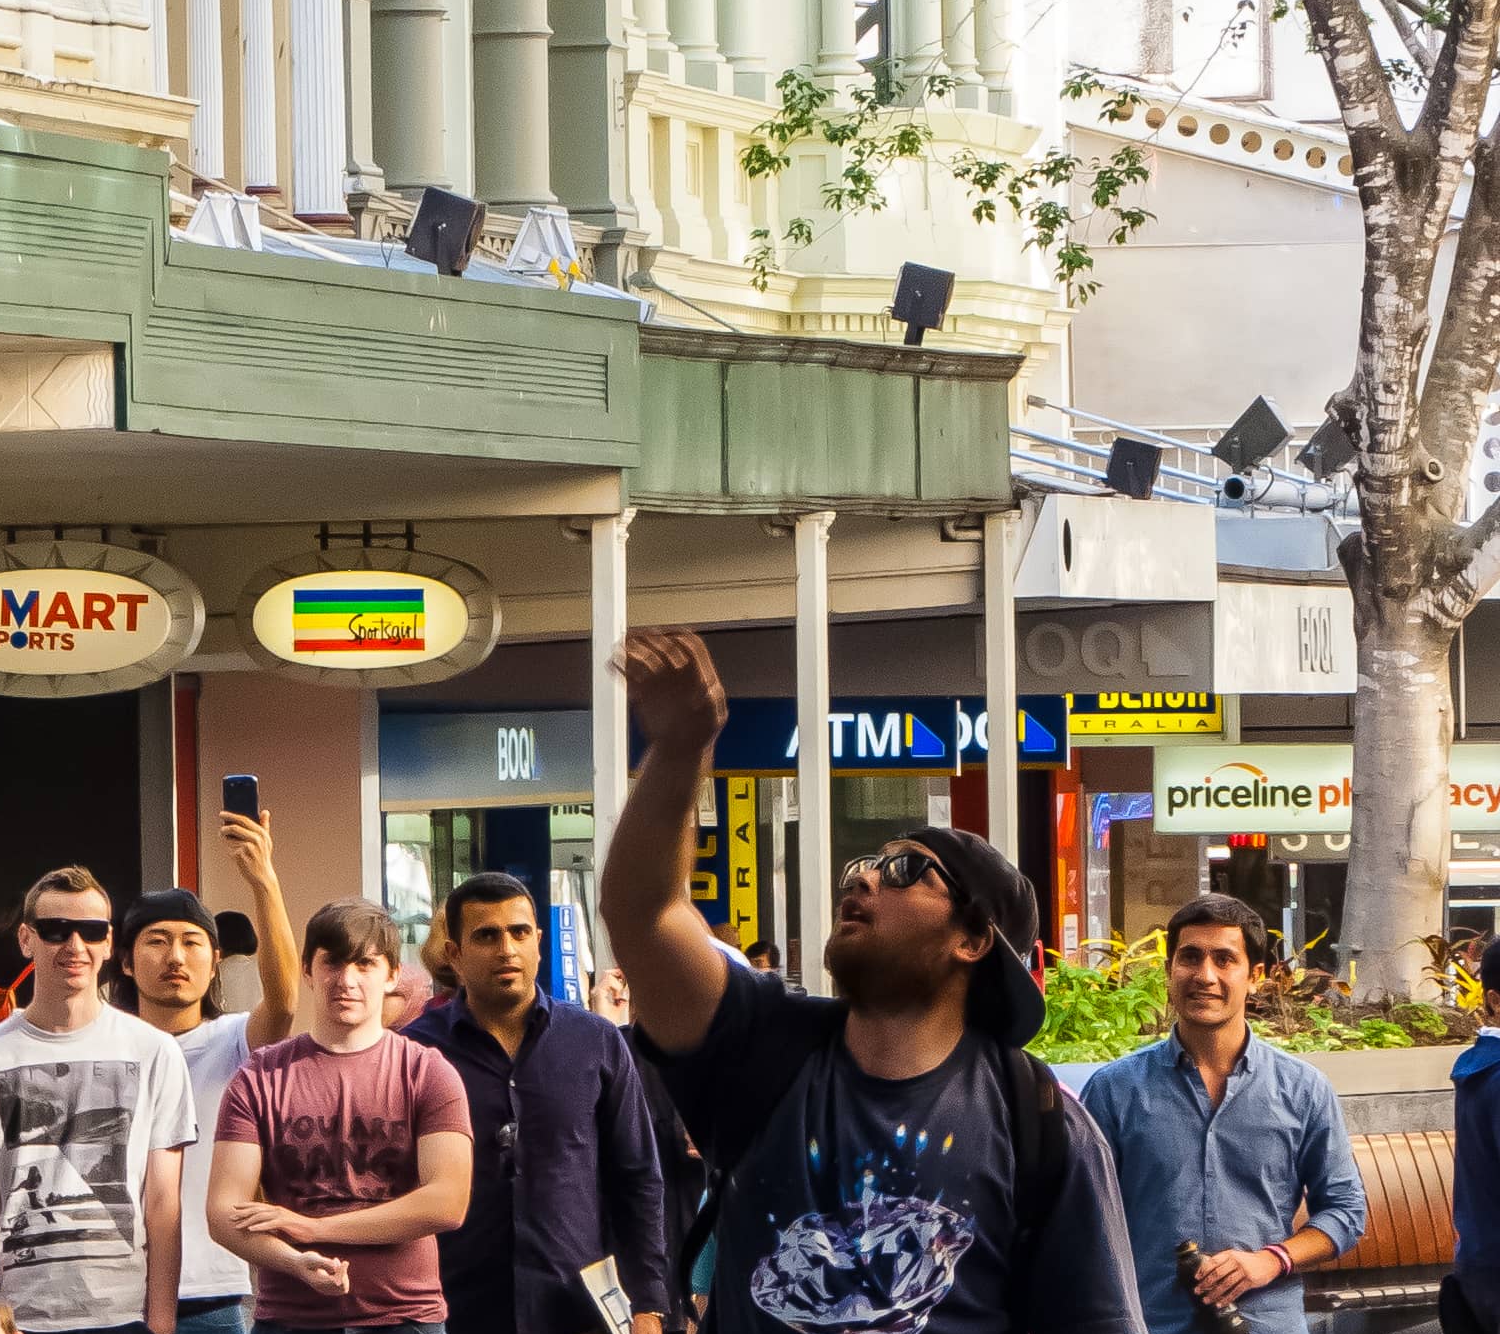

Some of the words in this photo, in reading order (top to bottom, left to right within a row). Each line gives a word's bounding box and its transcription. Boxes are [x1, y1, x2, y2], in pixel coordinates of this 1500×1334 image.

[348, 613, 419, 645] Sportsgirl
[1297, 605, 1333, 675] BOQ
[498, 727, 530, 781] BOQ
[1167, 776, 1312, 816] priceline
